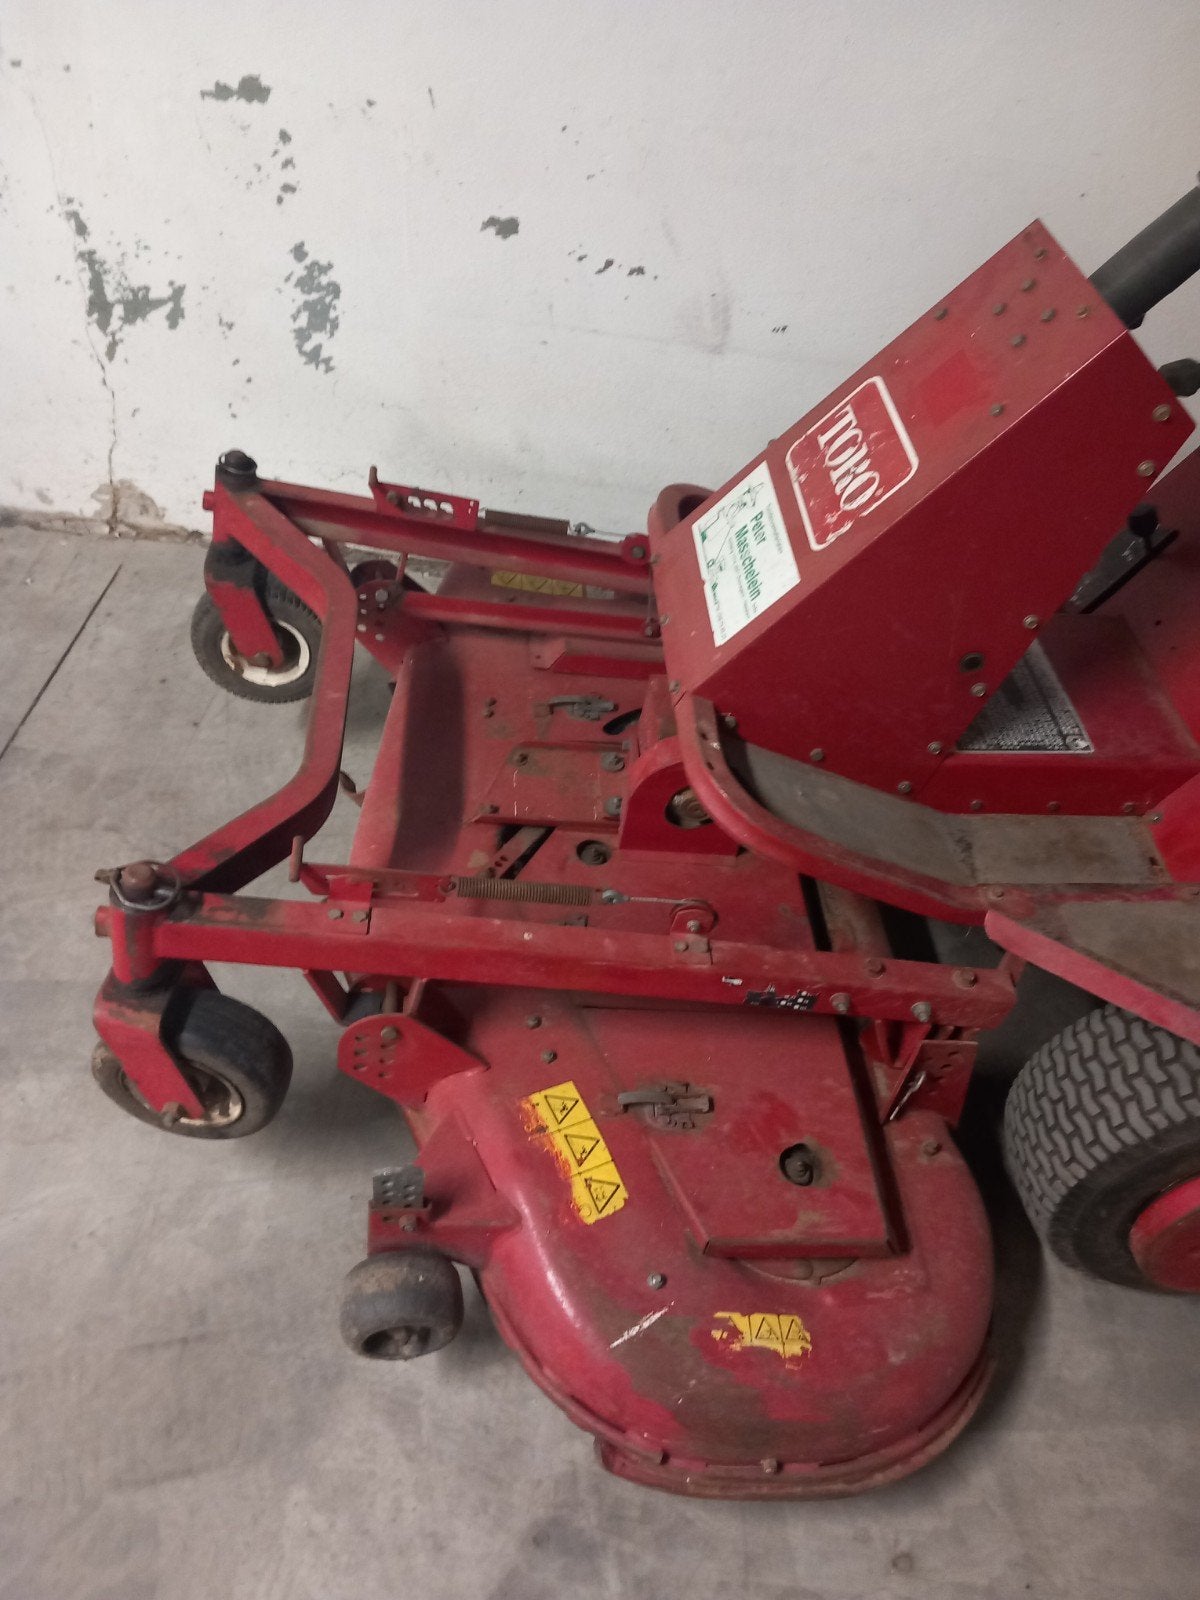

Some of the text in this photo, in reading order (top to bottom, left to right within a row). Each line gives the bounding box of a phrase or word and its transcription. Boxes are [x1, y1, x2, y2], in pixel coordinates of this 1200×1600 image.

[817, 404, 880, 511] TORO
[736, 524, 762, 601] Masschelein
[750, 511, 767, 546] Peter
